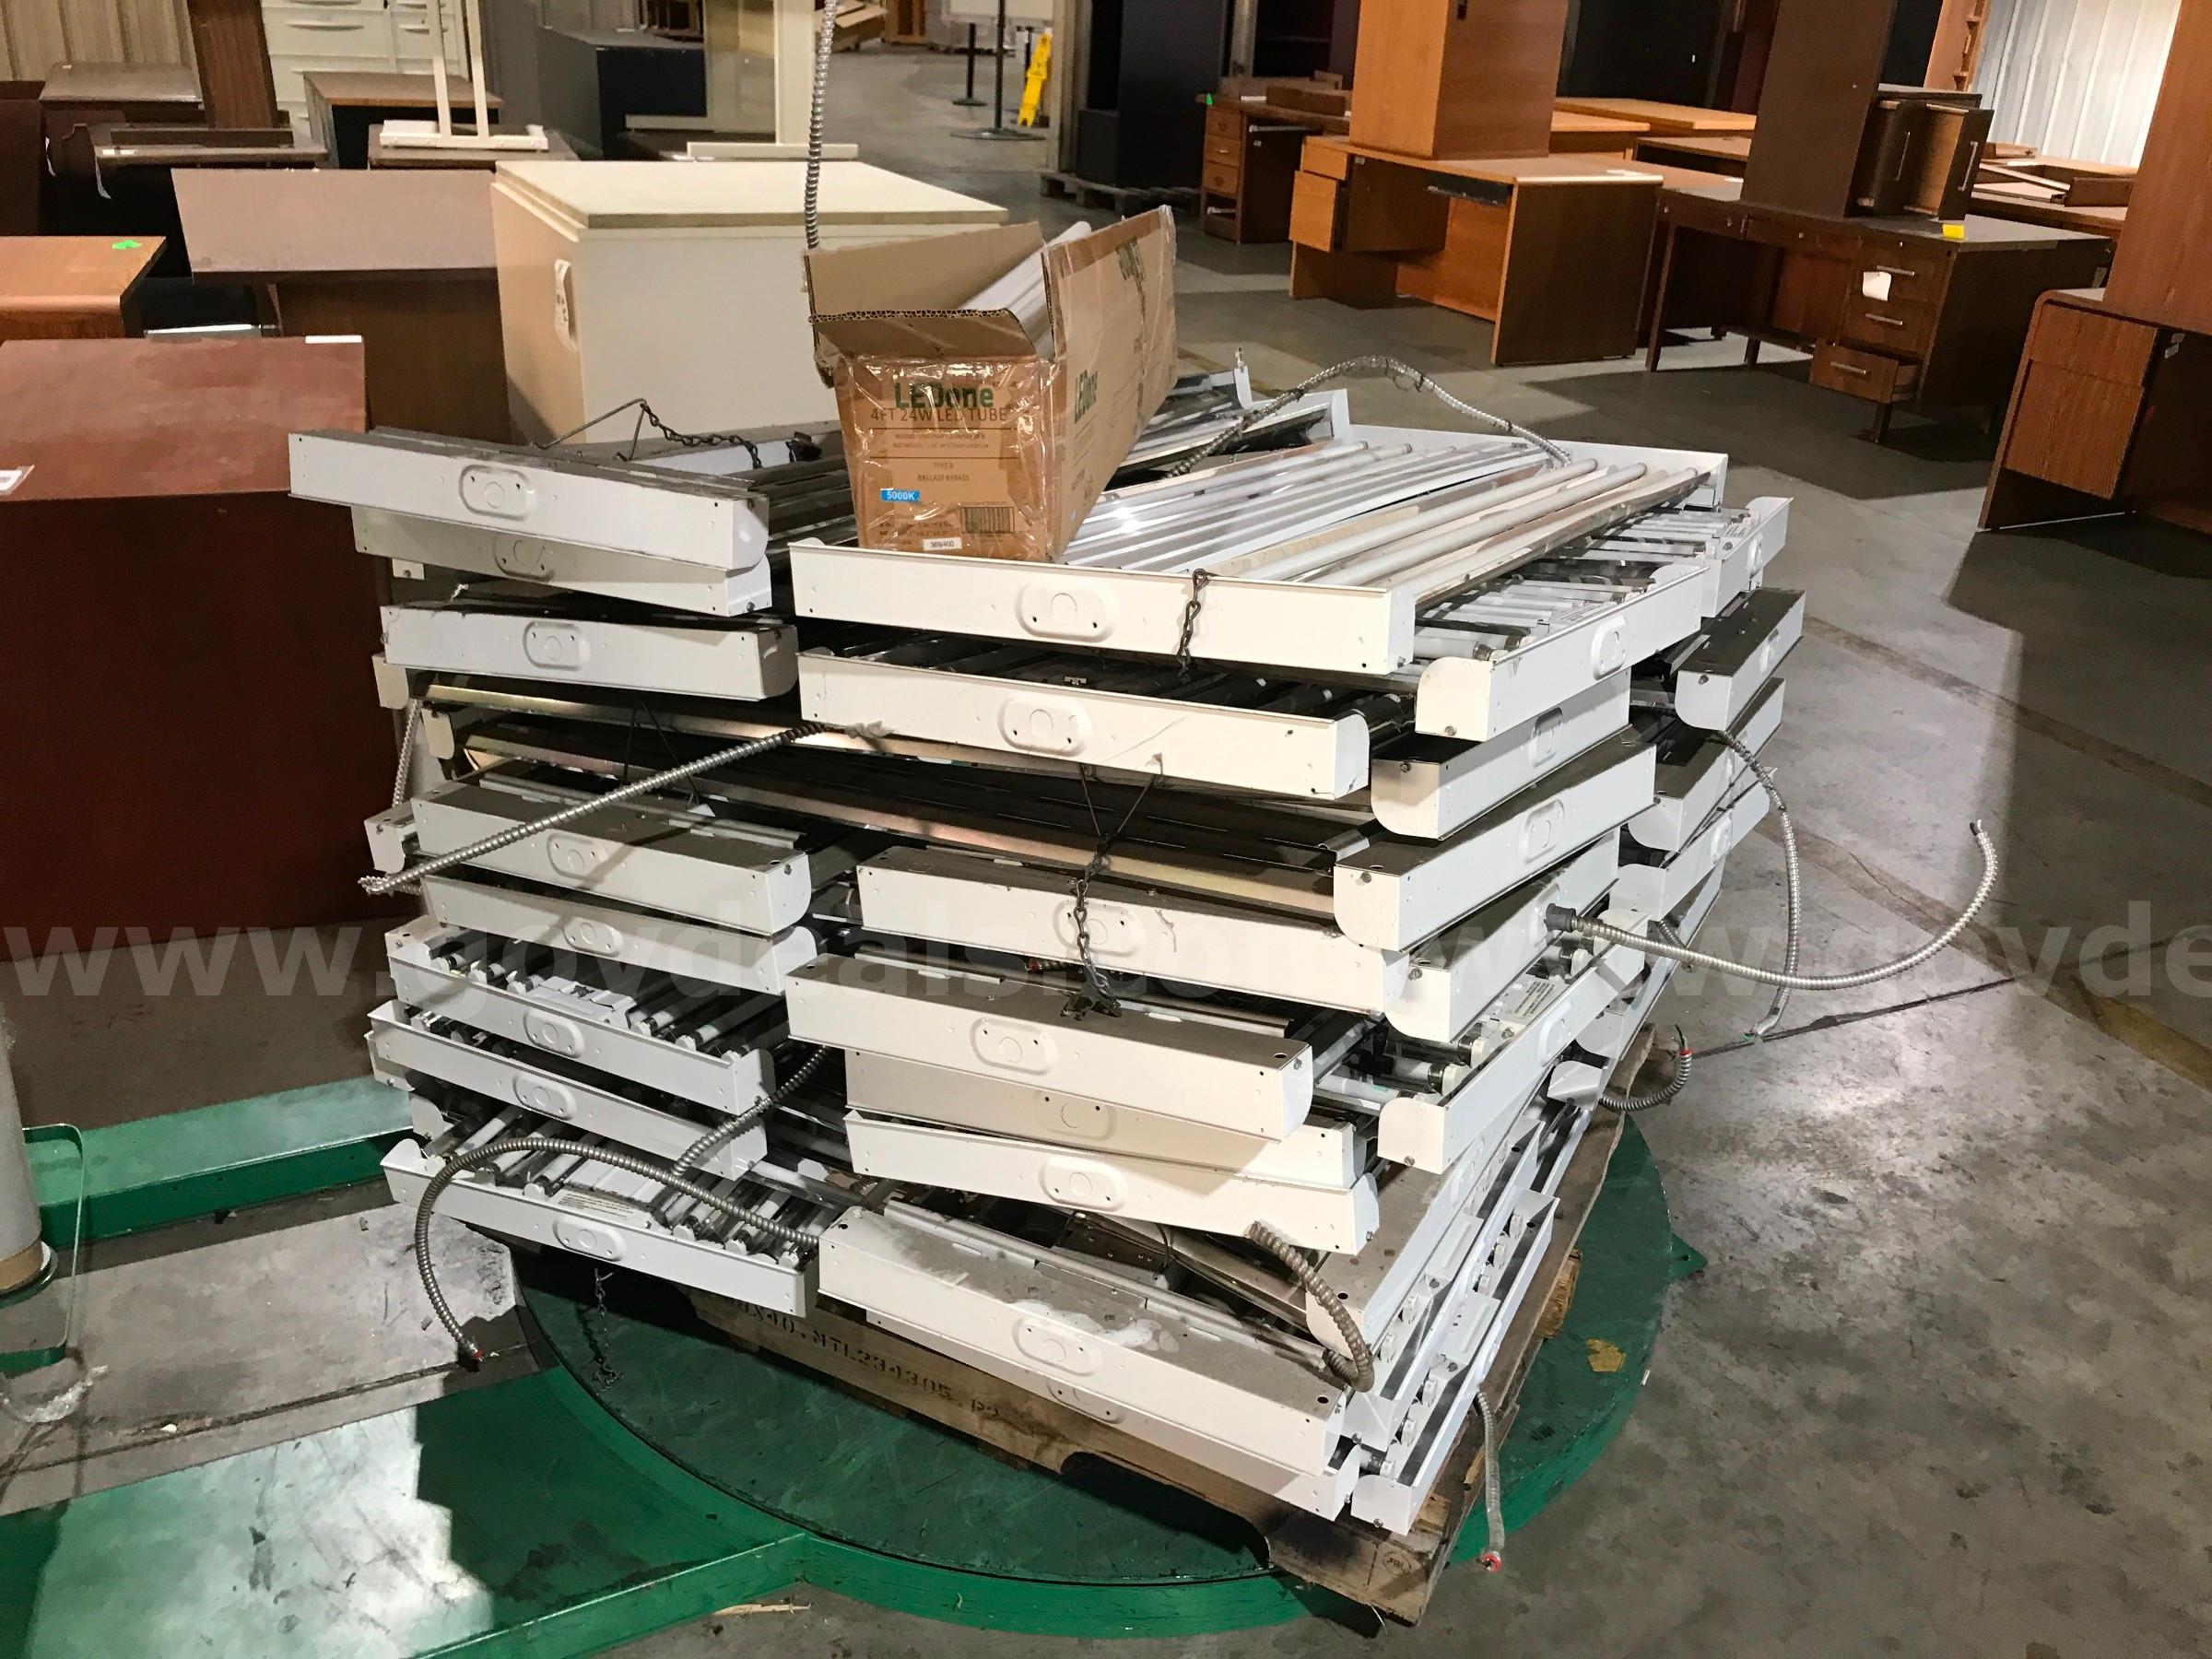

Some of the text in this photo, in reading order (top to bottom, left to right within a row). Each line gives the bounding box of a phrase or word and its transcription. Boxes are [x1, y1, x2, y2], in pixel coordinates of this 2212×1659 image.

[894, 381, 994, 408] LEDone
[870, 407, 1006, 422] 4FT 24W LED TUBE
[886, 490, 915, 500] 5000K
